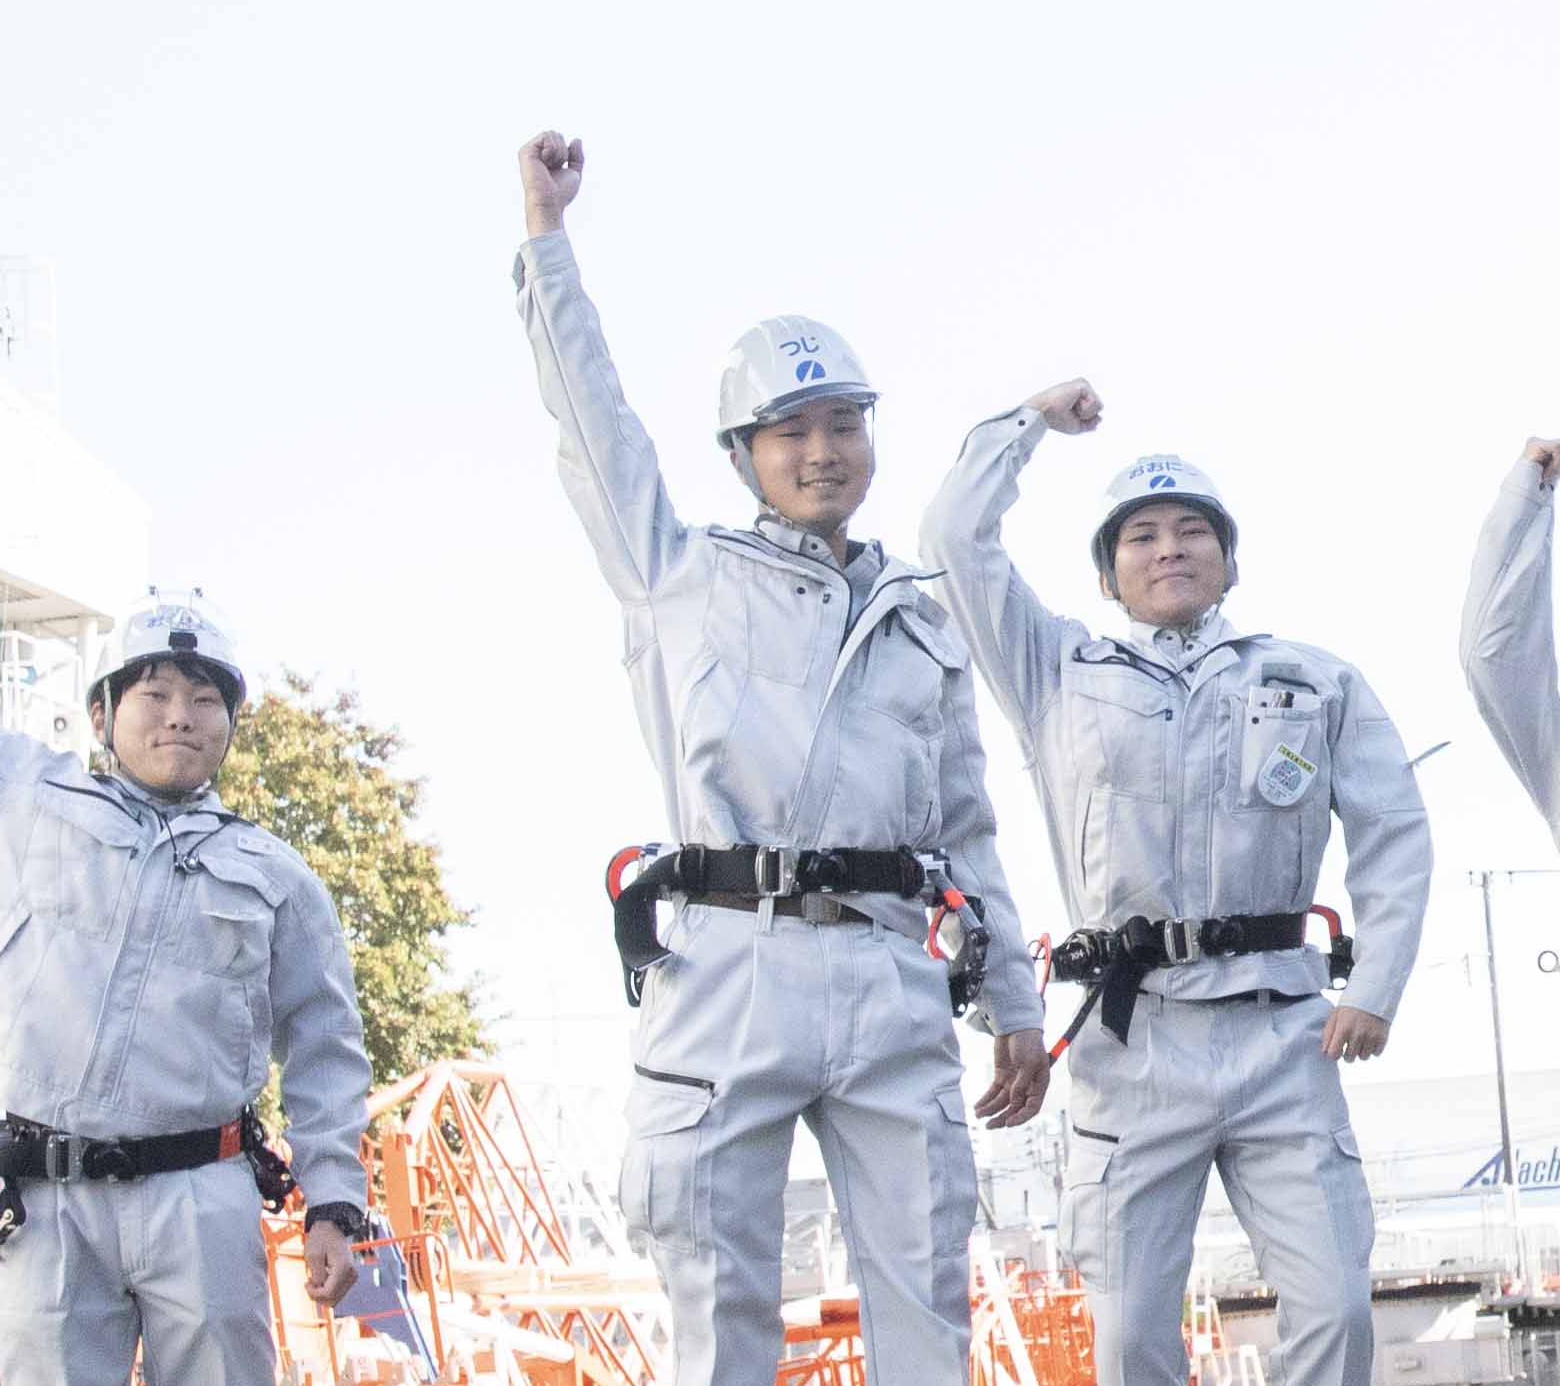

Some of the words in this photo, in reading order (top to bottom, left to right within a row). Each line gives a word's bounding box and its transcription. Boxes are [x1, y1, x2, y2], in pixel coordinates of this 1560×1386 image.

[779, 335, 820, 357] つじ
[1128, 459, 1202, 480] おおに
